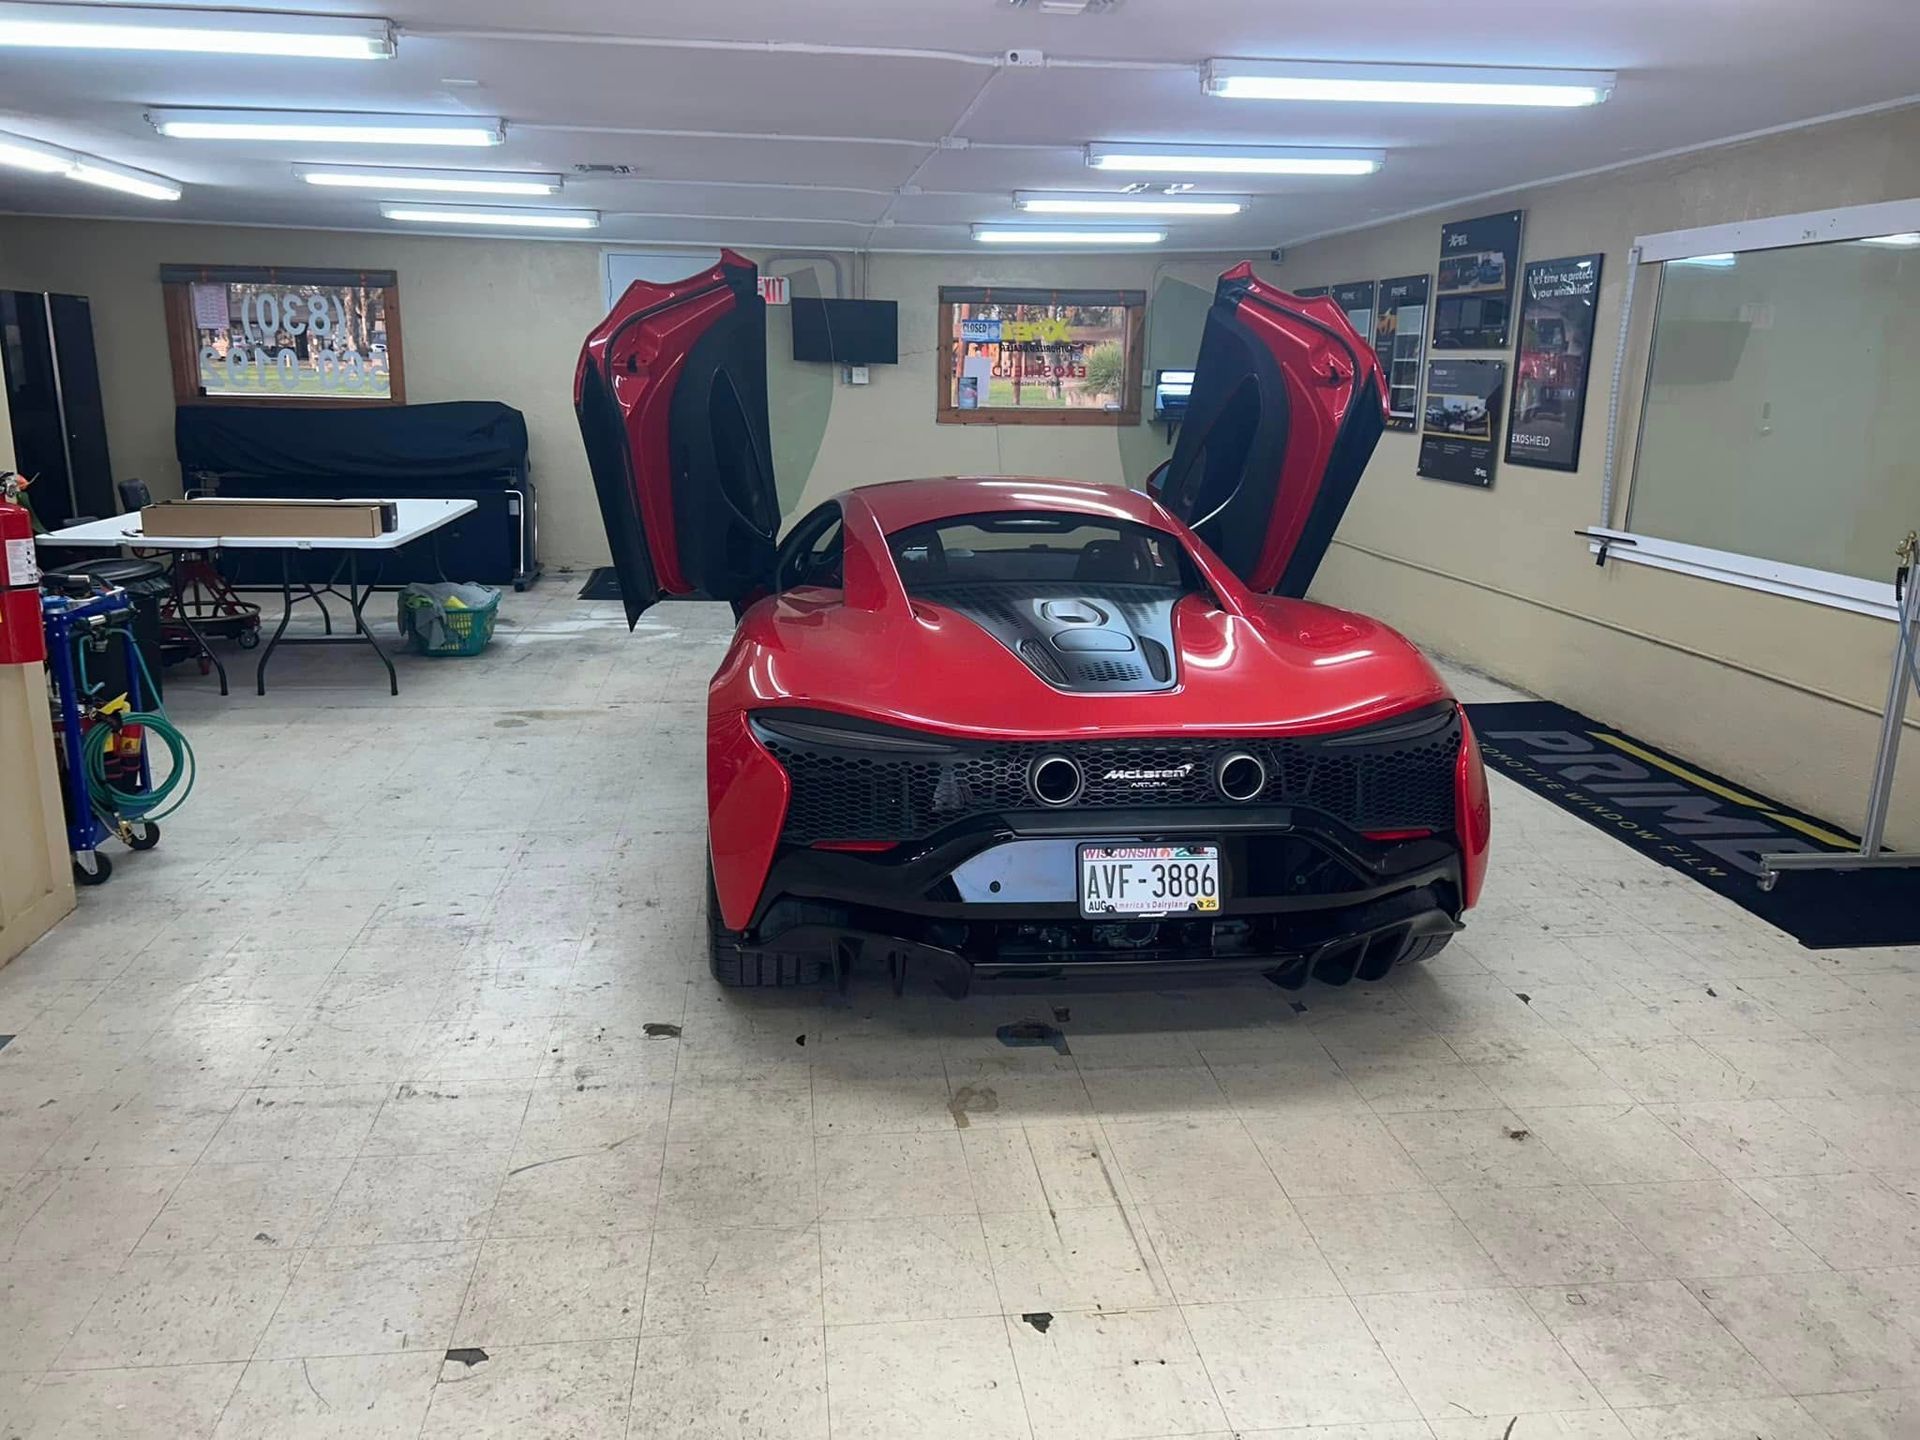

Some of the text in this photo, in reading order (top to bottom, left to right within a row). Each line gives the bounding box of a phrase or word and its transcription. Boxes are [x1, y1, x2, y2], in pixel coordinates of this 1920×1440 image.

[1560, 273, 1567, 282] to
[1568, 270, 1593, 282] protect
[963, 323, 987, 333] CLOSED
[1512, 433, 1551, 447] EXOSHIELD
[1103, 769, 1185, 779] McLaren
[1564, 792, 1663, 840] WINDOW
[1659, 845, 1728, 877] FILM
[1088, 864, 1216, 899] AVF-3886
[1088, 900, 1107, 912] AUG
[1205, 900, 1216, 908] 25
